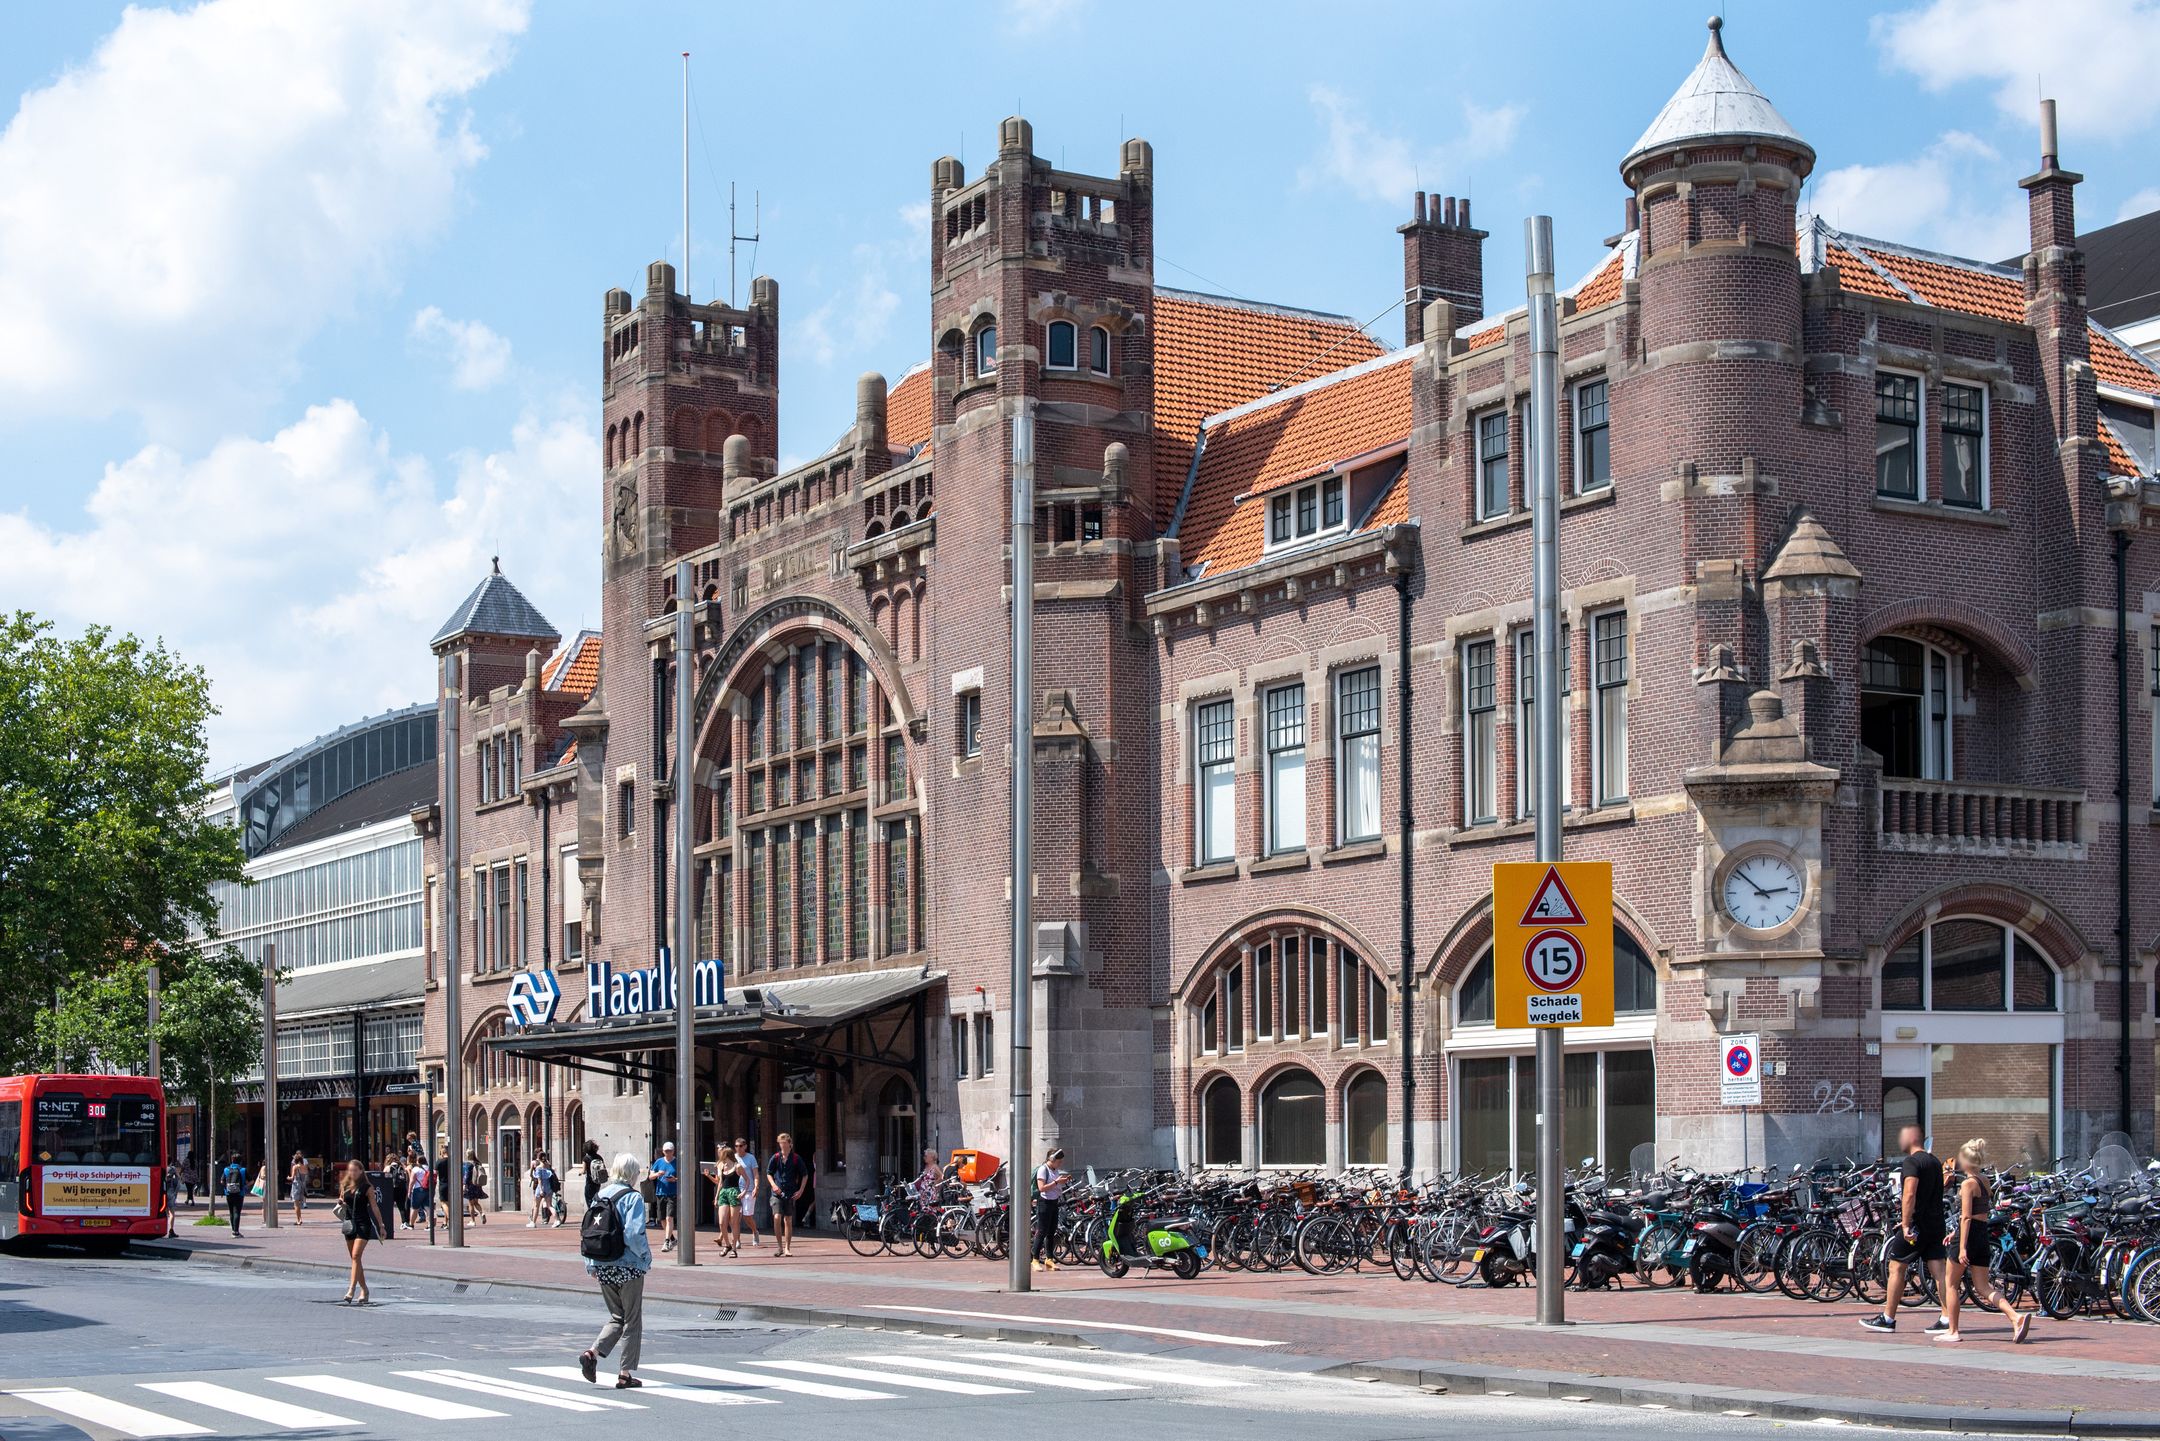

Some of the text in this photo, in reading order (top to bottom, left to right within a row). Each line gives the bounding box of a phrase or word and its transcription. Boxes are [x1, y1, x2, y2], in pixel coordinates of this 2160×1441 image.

[1539, 947, 1572, 975] 15
[1530, 996, 1578, 1007] Schade
[1530, 1010, 1580, 1023] wegdek
[89, 1105, 106, 1116] 300
[52, 1171, 63, 1179] Op
[65, 1171, 78, 1179] tijd
[91, 1171, 122, 1179] Schiphol
[124, 1172, 141, 1180] zijn?
[63, 1186, 131, 1196] Wij brengen je!
[1158, 1237, 1172, 1247] GO
